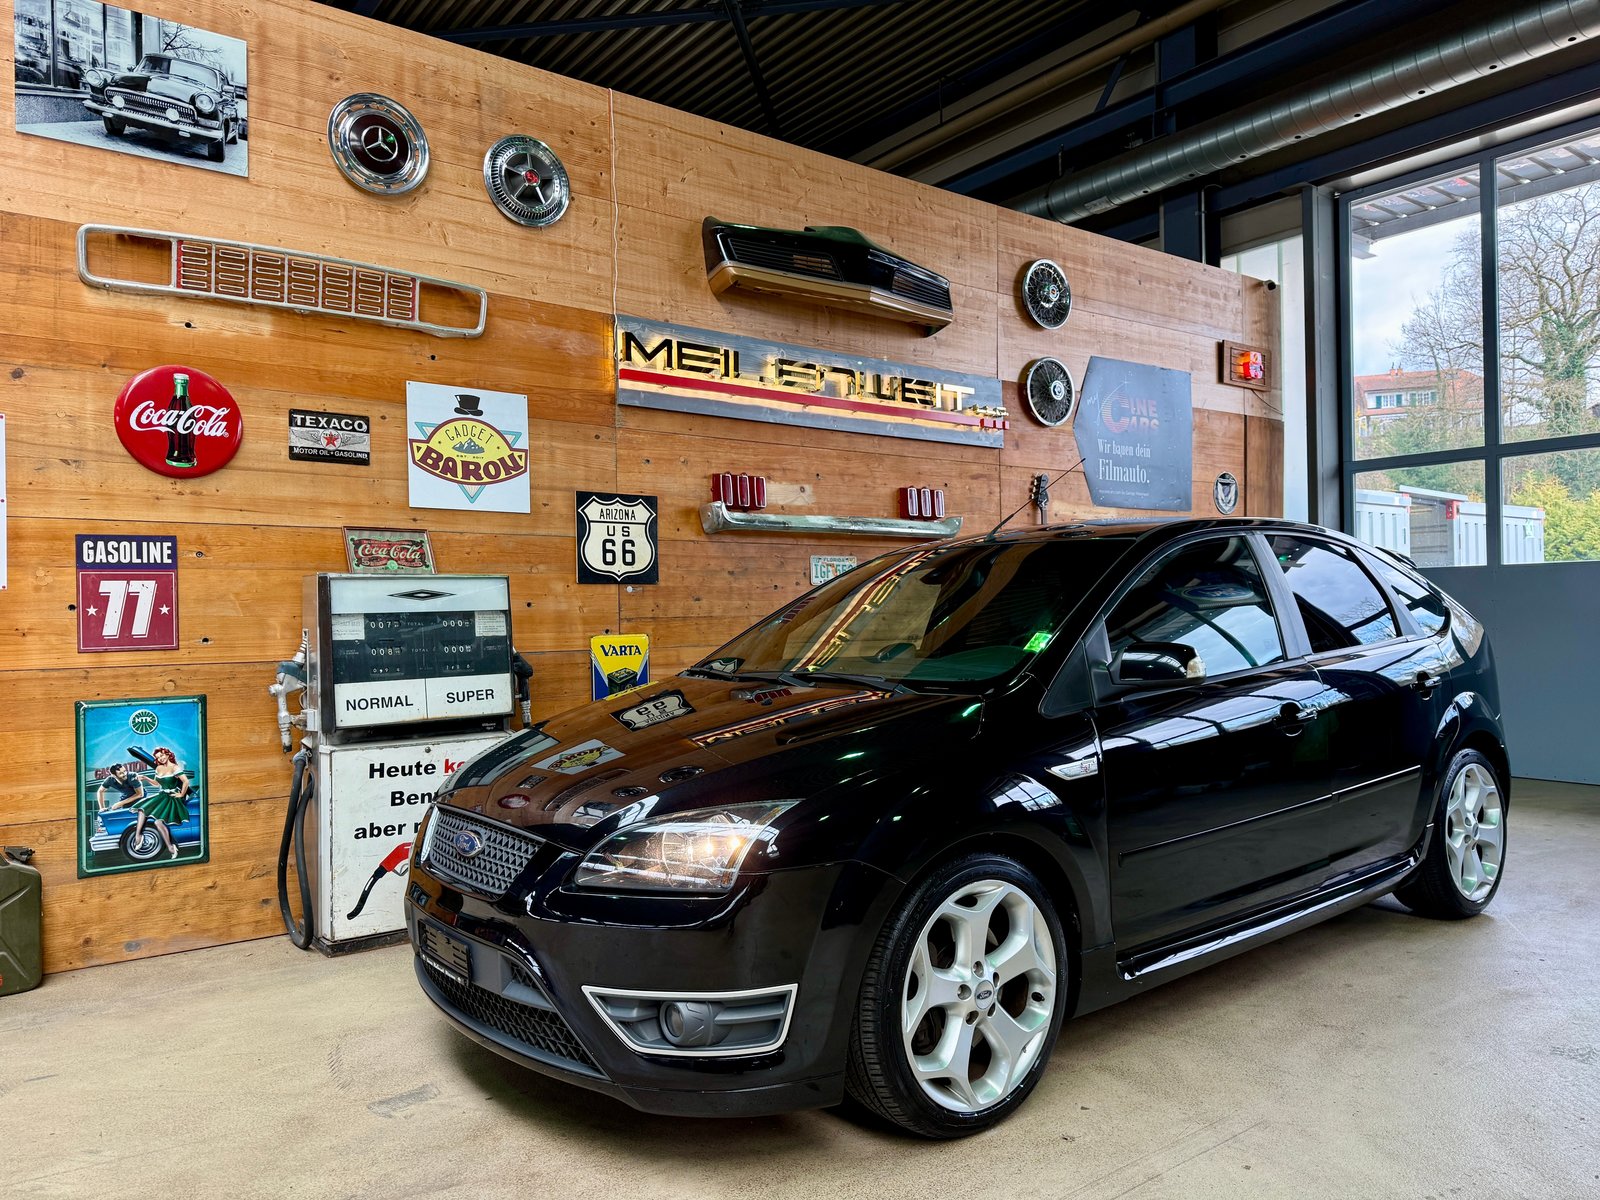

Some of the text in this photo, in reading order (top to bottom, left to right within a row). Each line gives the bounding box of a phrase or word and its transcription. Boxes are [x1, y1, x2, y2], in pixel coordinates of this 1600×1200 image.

[129, 400, 231, 437] Coca-Cola
[292, 414, 368, 432] TEXACO
[445, 424, 495, 444] GADGET
[293, 447, 318, 455] MOTOR
[1097, 438, 1151, 458] Wir bauen dein
[416, 445, 524, 481] BARON
[1099, 458, 1150, 484] Filmauto.
[600, 508, 636, 521] ARIZONA
[82, 540, 173, 564] GASOLINE
[357, 543, 422, 560] Coca-Cola
[602, 538, 636, 566] 66
[98, 580, 157, 639] 77
[600, 644, 642, 657] VARTA
[346, 689, 495, 711] NORMAL SUPER
[369, 761, 437, 779] Heute
[391, 790, 438, 807] Ben
[354, 822, 407, 840] aber
